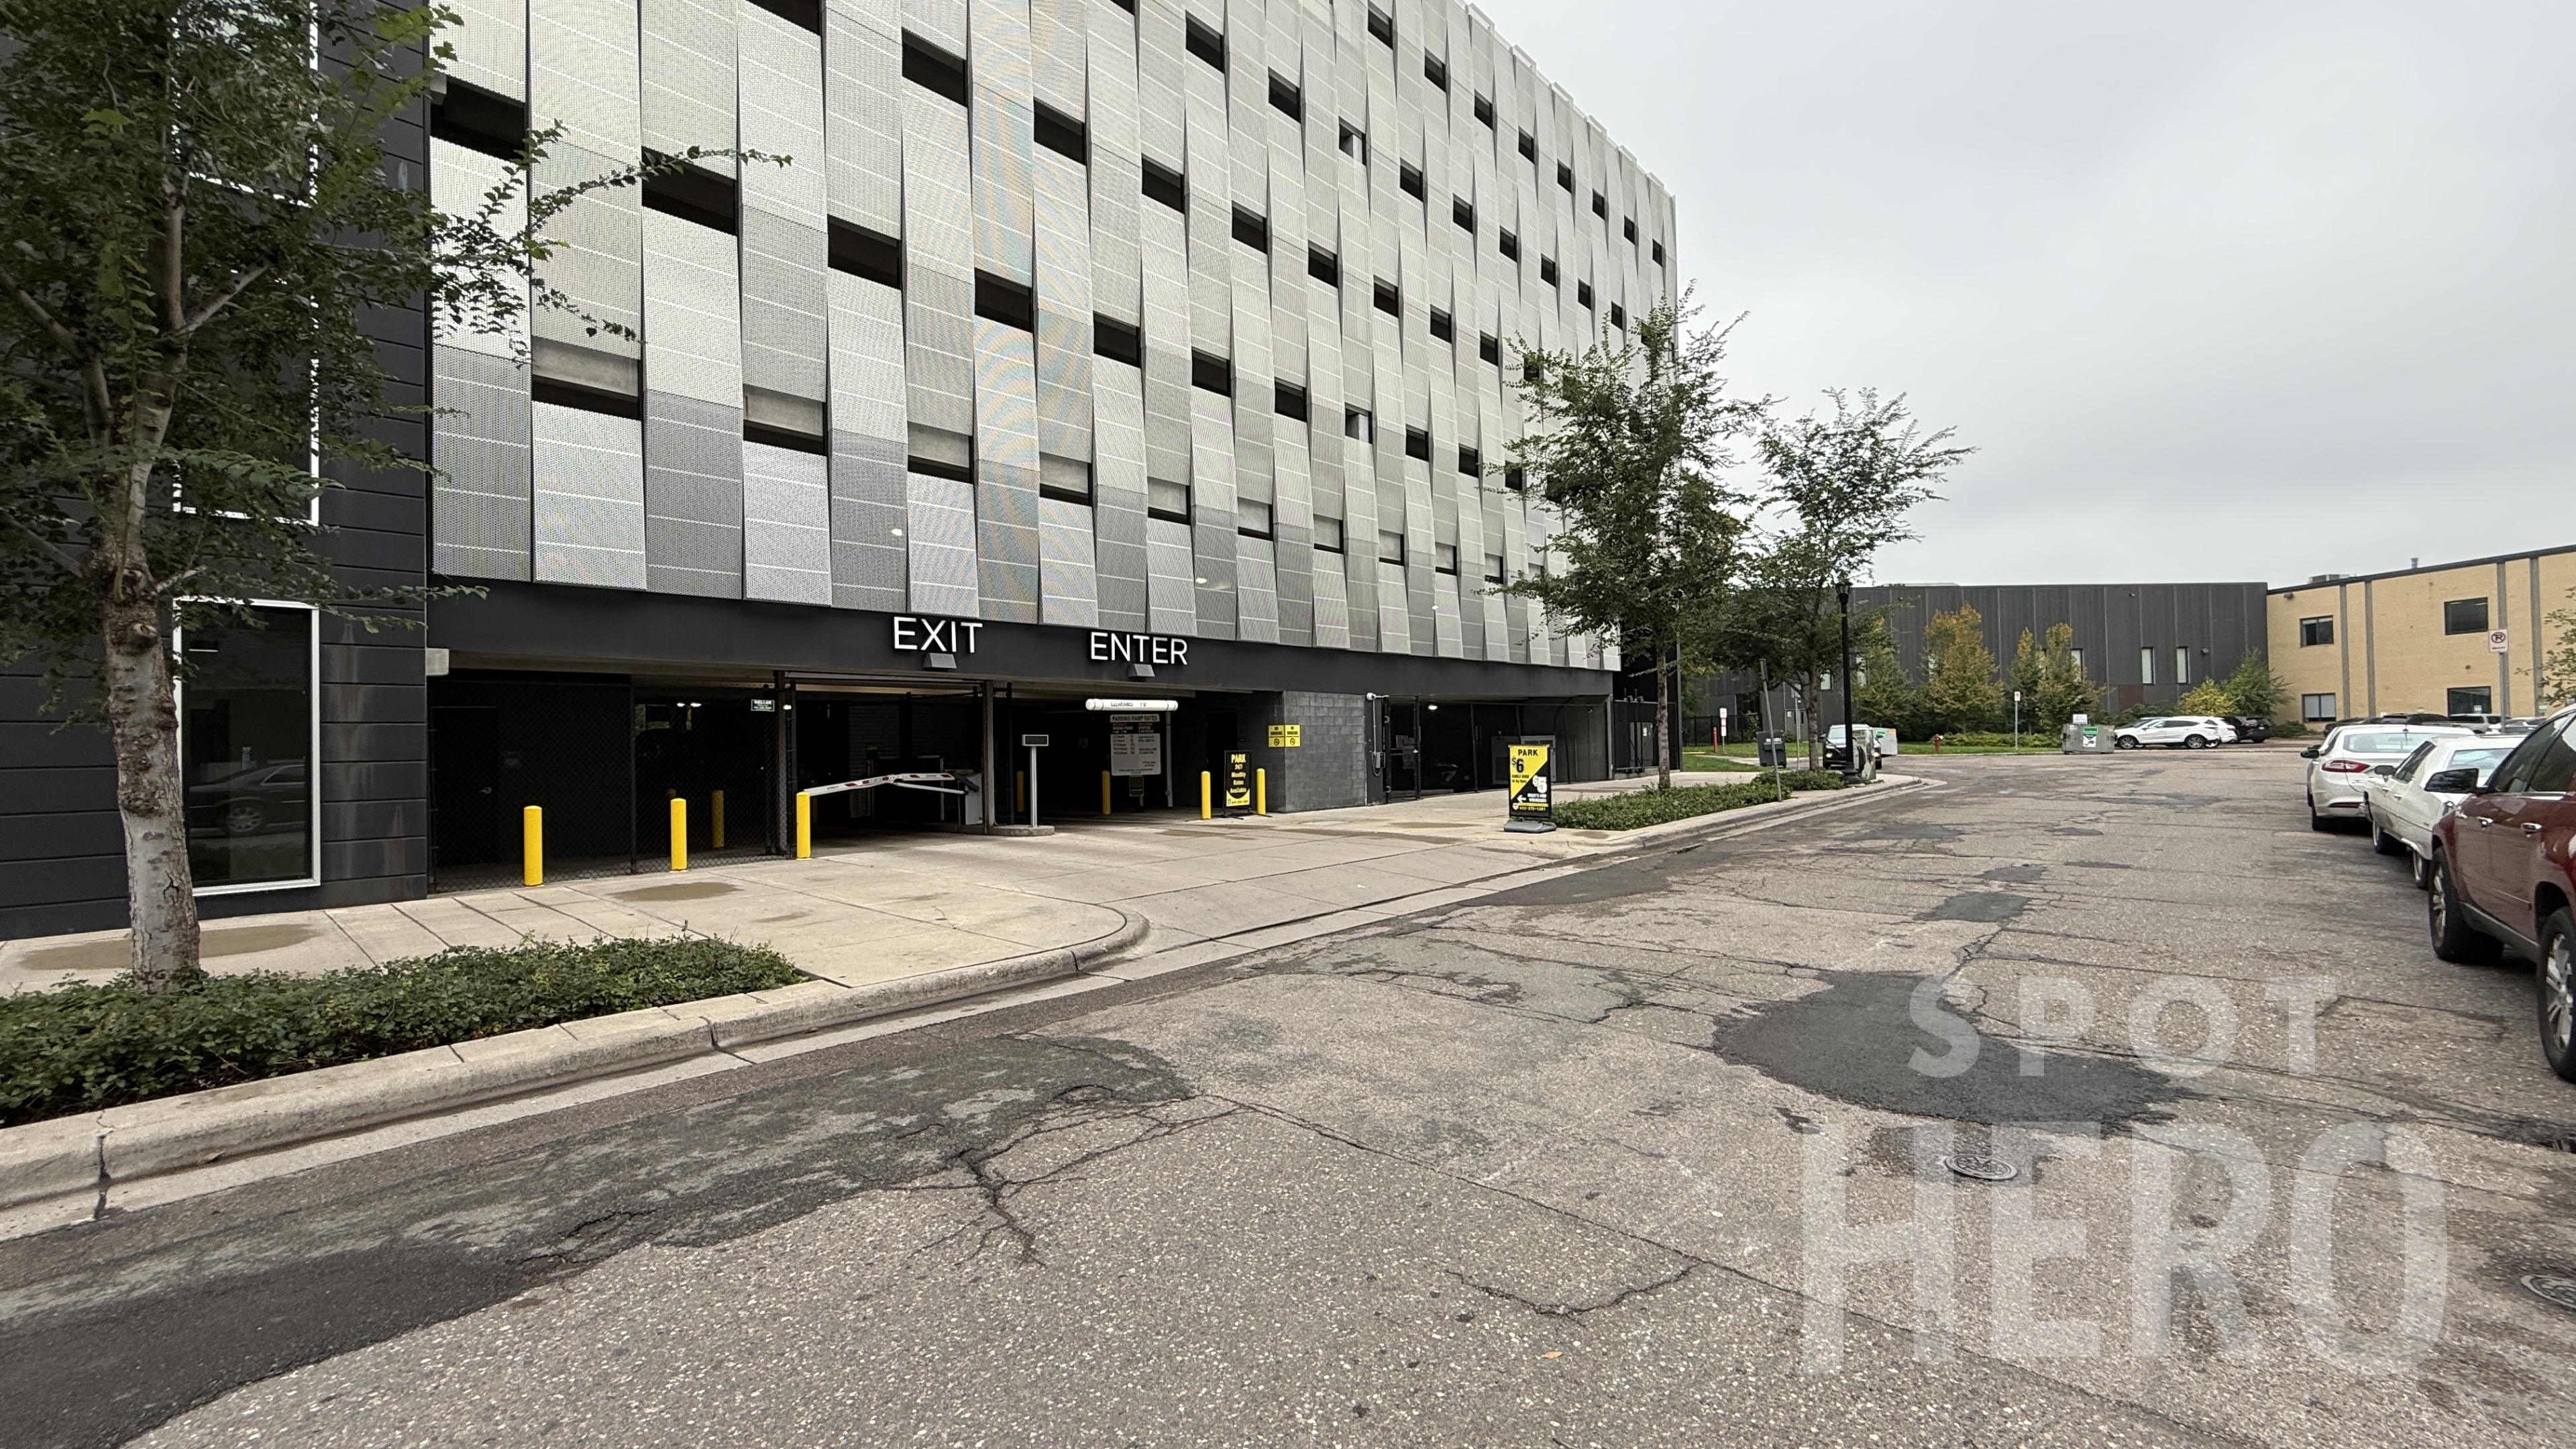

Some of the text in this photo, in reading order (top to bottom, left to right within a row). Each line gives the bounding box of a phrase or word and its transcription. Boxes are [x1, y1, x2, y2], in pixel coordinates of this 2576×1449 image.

[893, 616, 983, 653] EXIT
[1090, 632, 1188, 665] ENTER
[1231, 753, 1246, 763] PARK
[1511, 756, 1524, 773] $6
[1532, 775, 1548, 794] $5
